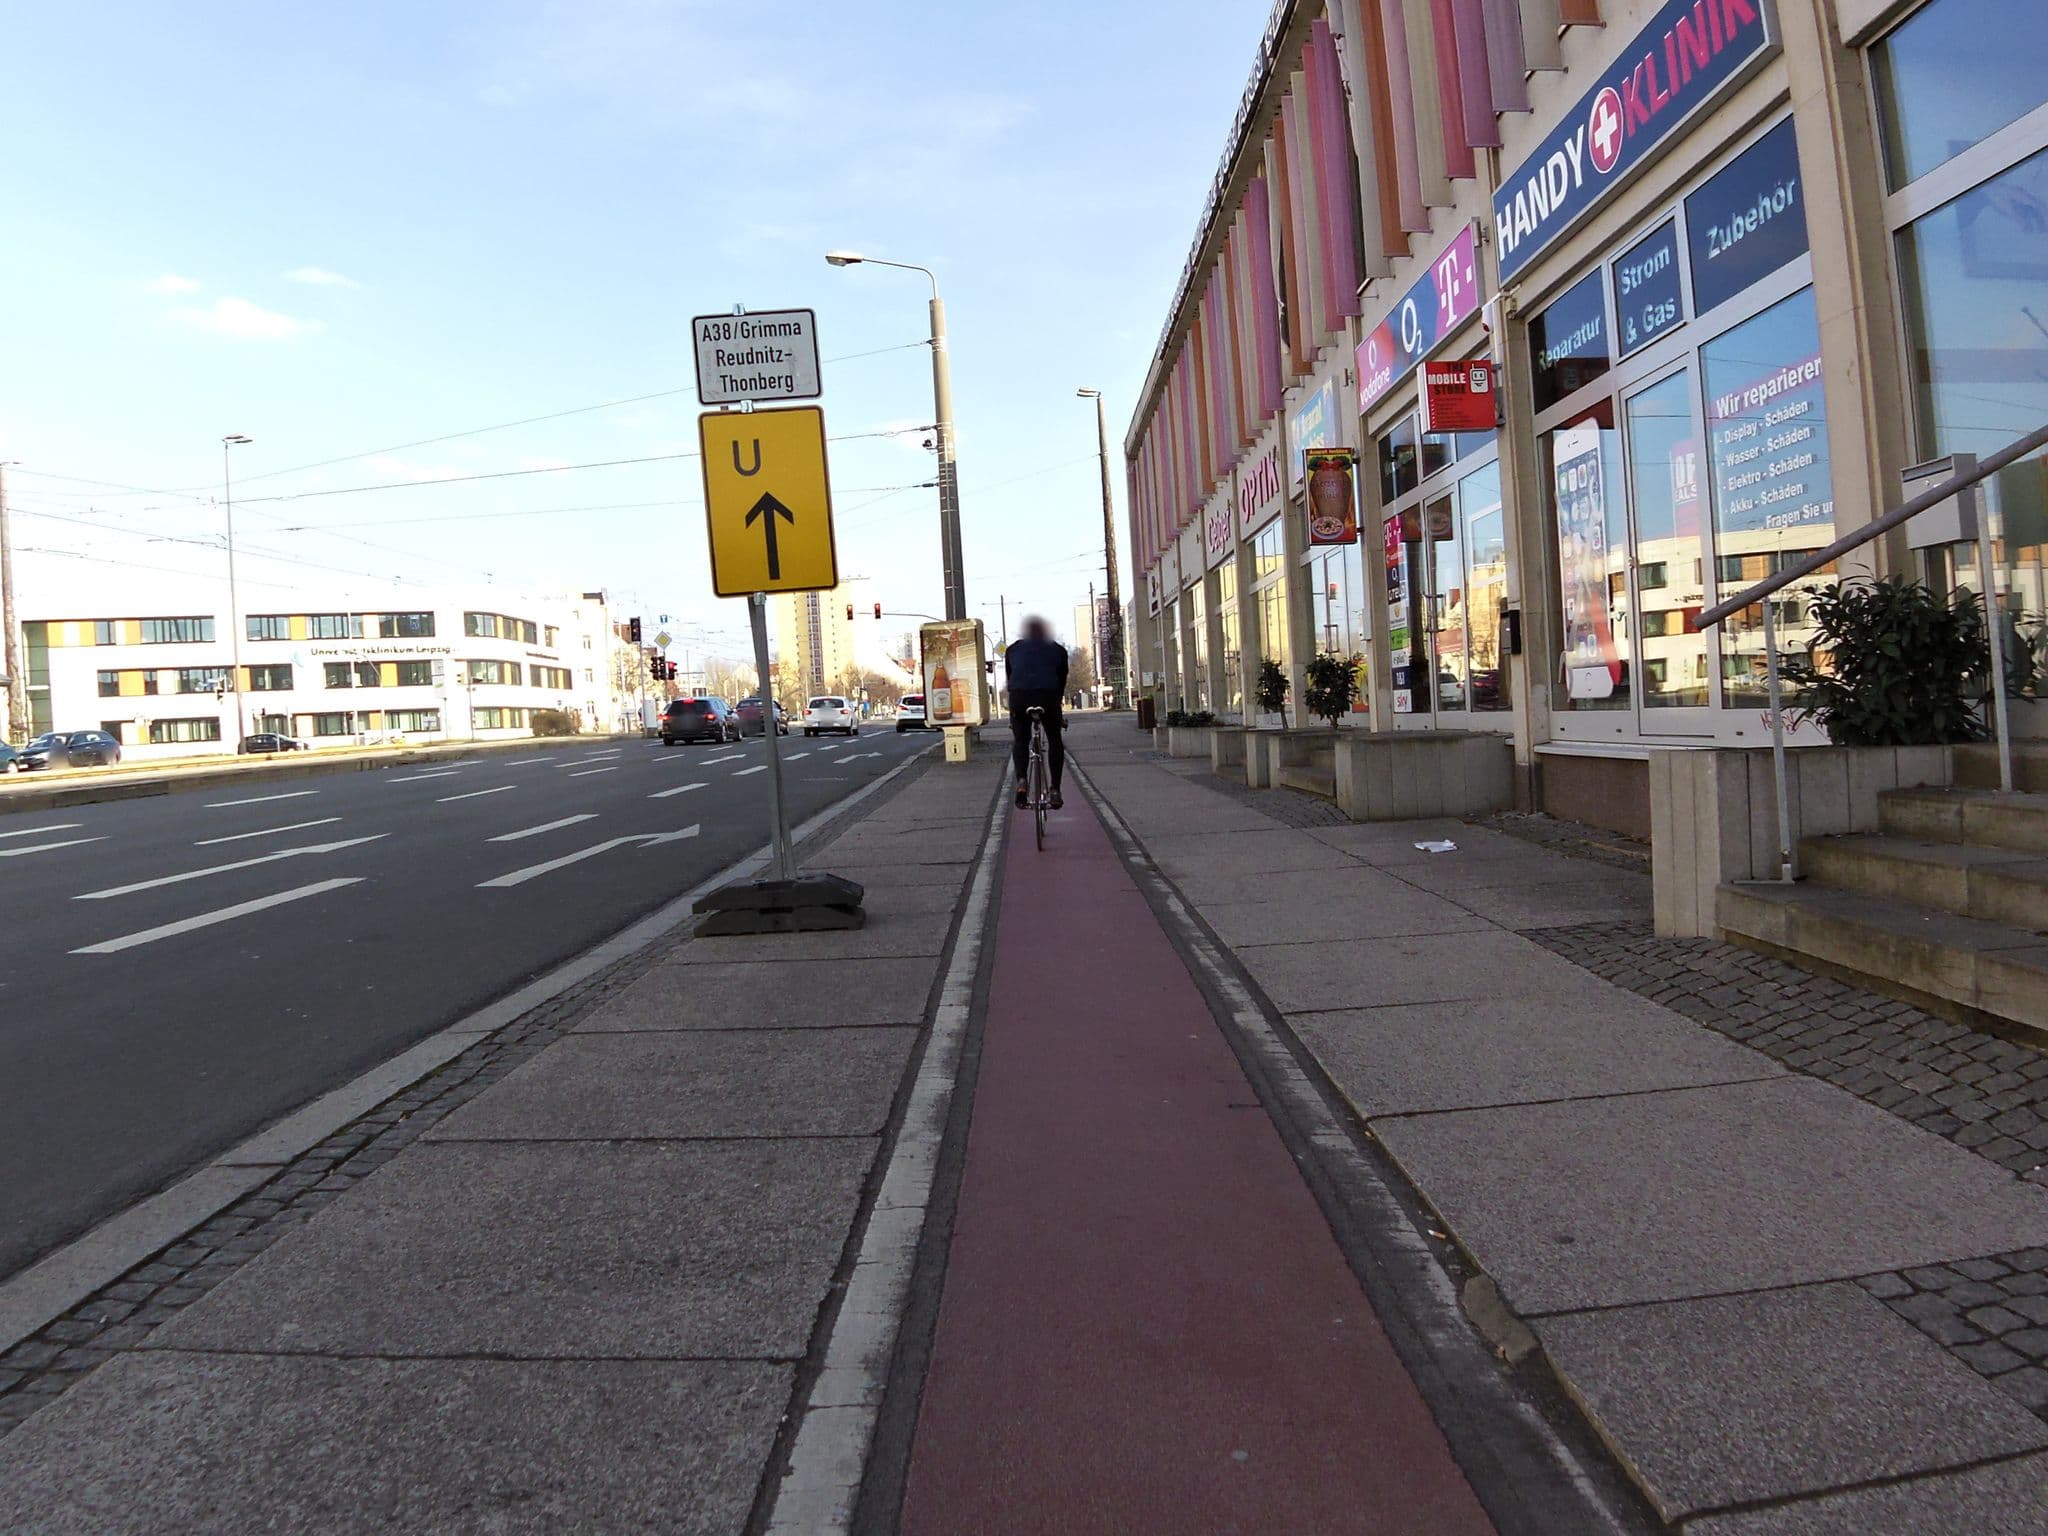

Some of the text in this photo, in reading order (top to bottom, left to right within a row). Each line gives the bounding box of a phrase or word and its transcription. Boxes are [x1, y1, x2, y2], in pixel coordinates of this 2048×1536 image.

[1495, 0, 1756, 261] HANDY KLINIK
[1706, 178, 1796, 260] Zubehör
[1621, 244, 1671, 296] Strom
[702, 321, 802, 342] A38/Grimma
[1626, 297, 1676, 345] & Gas
[1538, 315, 1600, 372] Reparatur
[716, 348, 793, 368] Reudnitz-
[720, 373, 794, 393] Thonberg
[1360, 367, 1390, 406] vodafone
[1428, 373, 1466, 385] MOBILE
[1716, 393, 1740, 419] Wir
[1724, 421, 1757, 443] Display
[732, 438, 761, 477] U
[1725, 446, 1760, 467] Wasser
[1241, 453, 1280, 524] OPTIK
[1727, 471, 1761, 491] Elektro
[1730, 498, 1753, 514] Akku
[1766, 511, 1800, 528] Fragen
[1802, 503, 1820, 518] Sie
